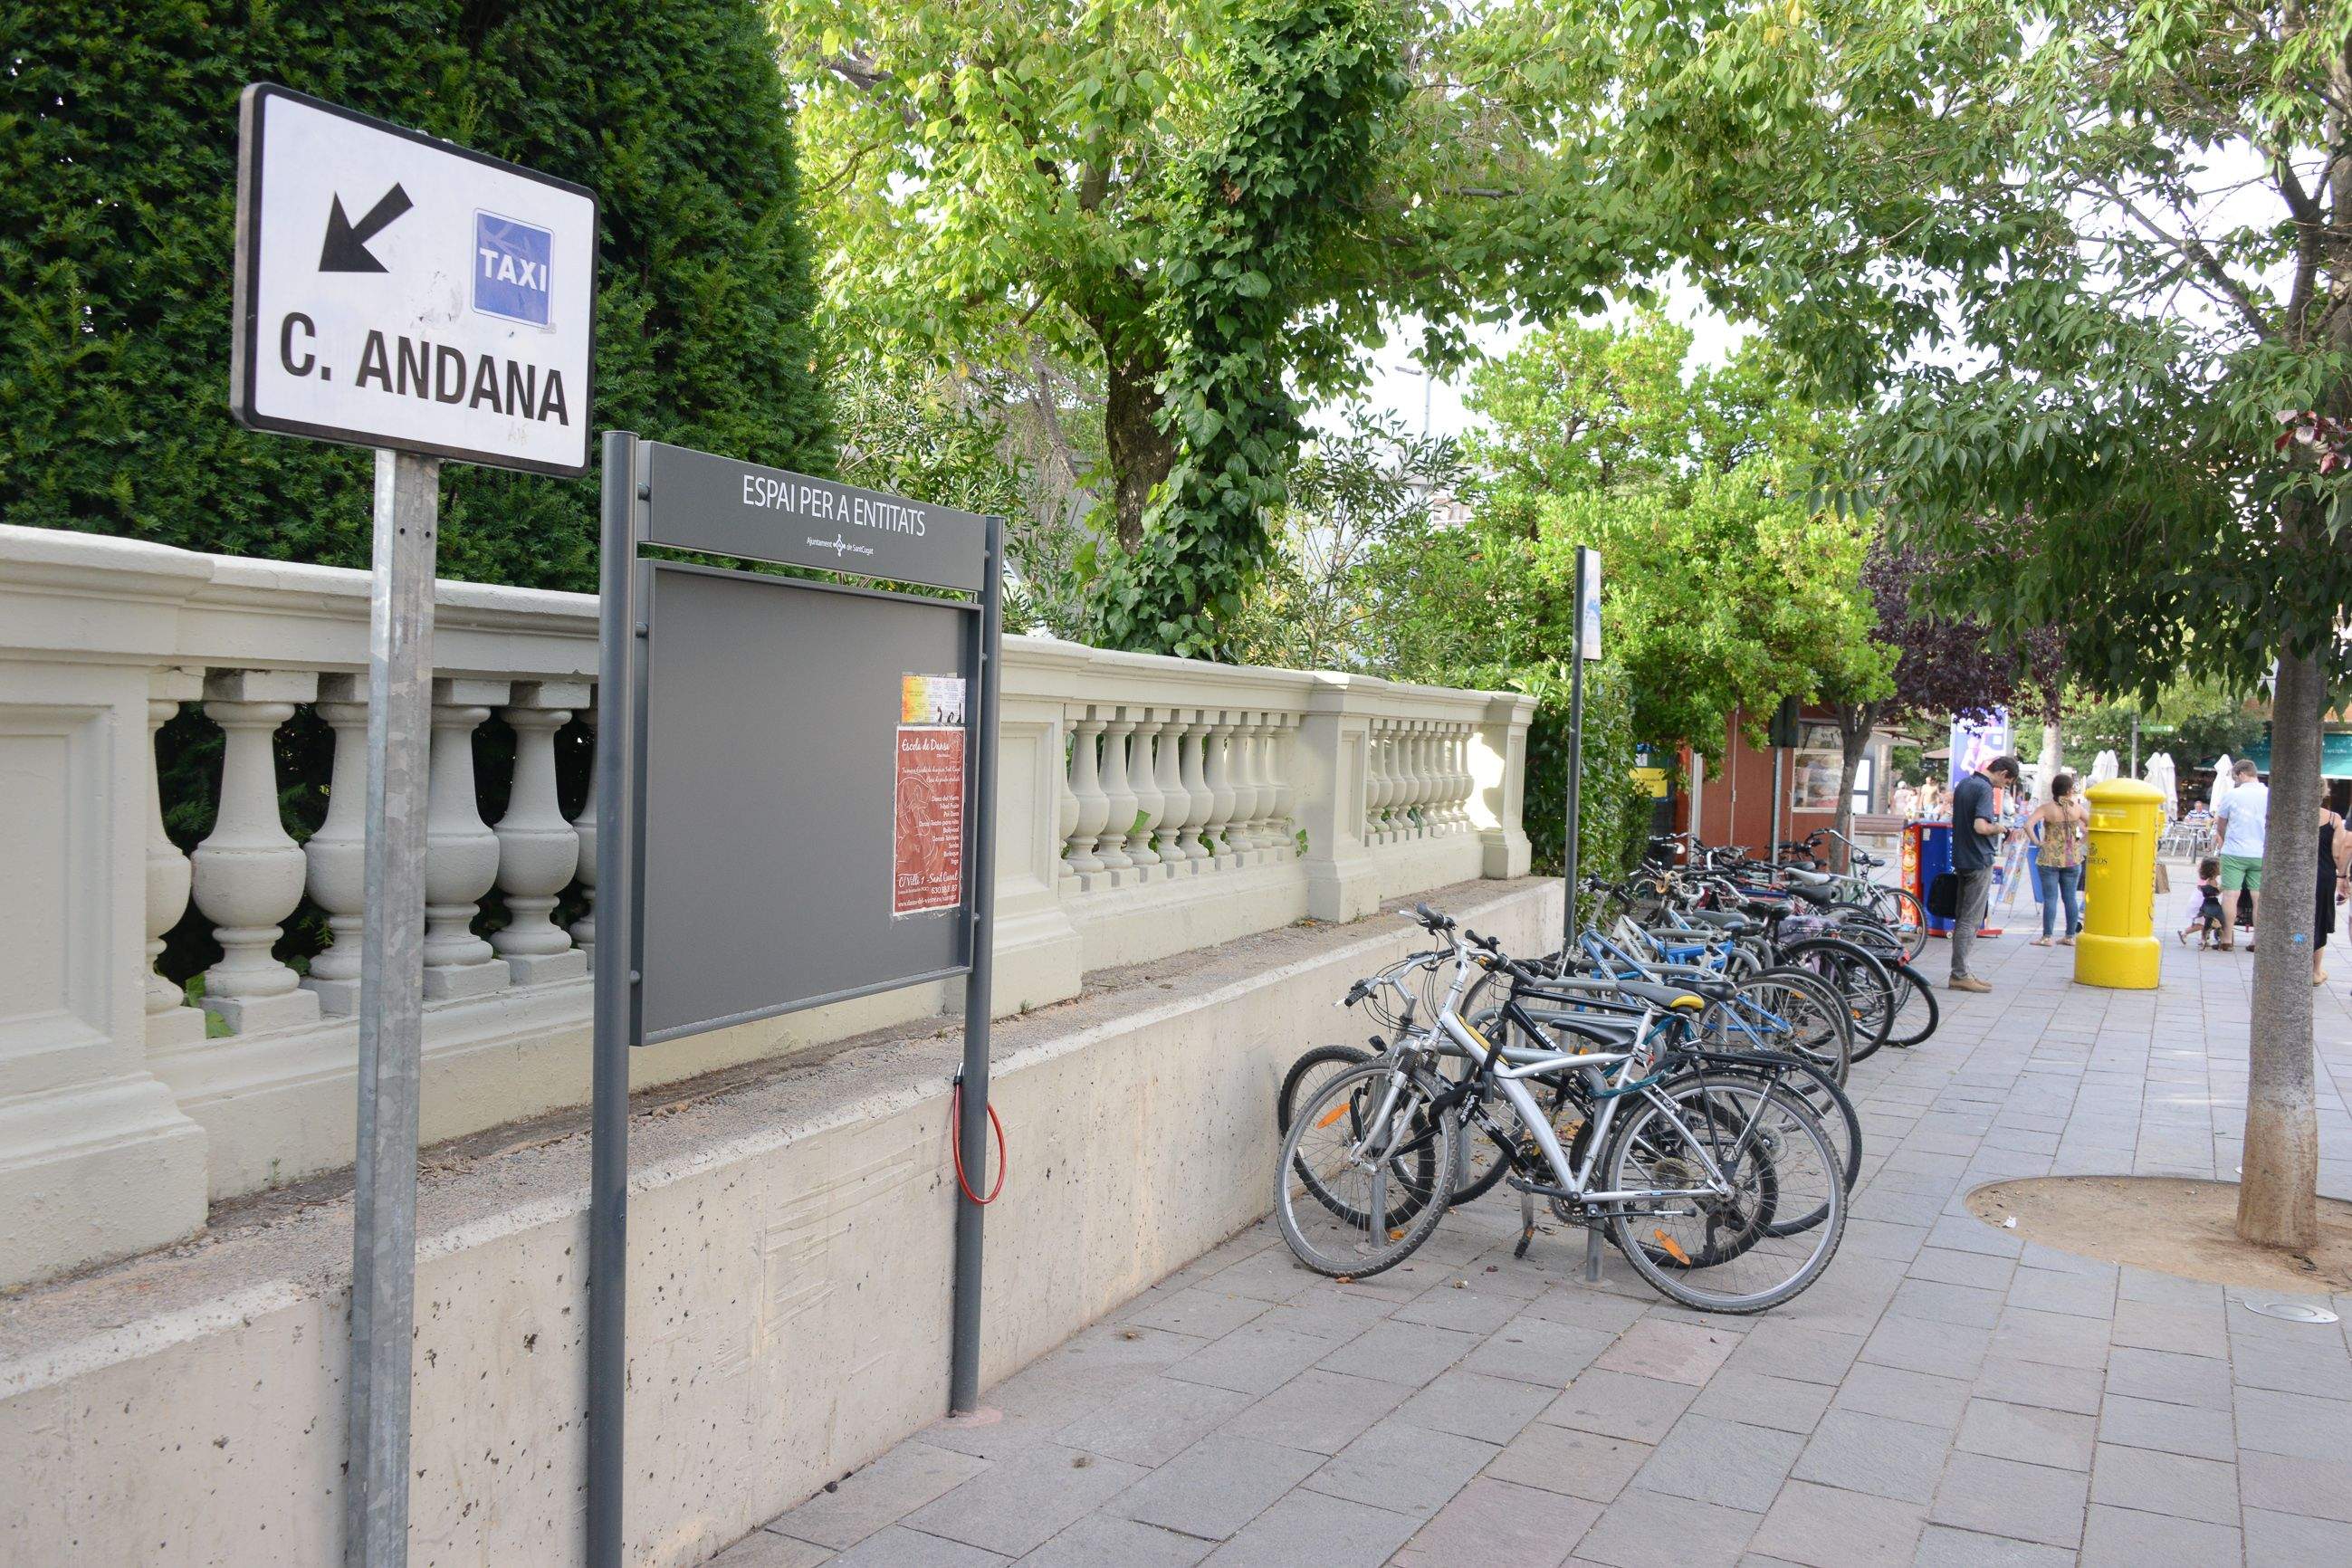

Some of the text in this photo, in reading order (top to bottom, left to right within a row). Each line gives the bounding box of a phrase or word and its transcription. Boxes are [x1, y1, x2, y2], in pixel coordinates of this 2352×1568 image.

[480, 248, 547, 292] TAXI
[281, 311, 569, 426] C. ANDANA
[743, 474, 925, 537] ESPAI PER A ENTITATS
